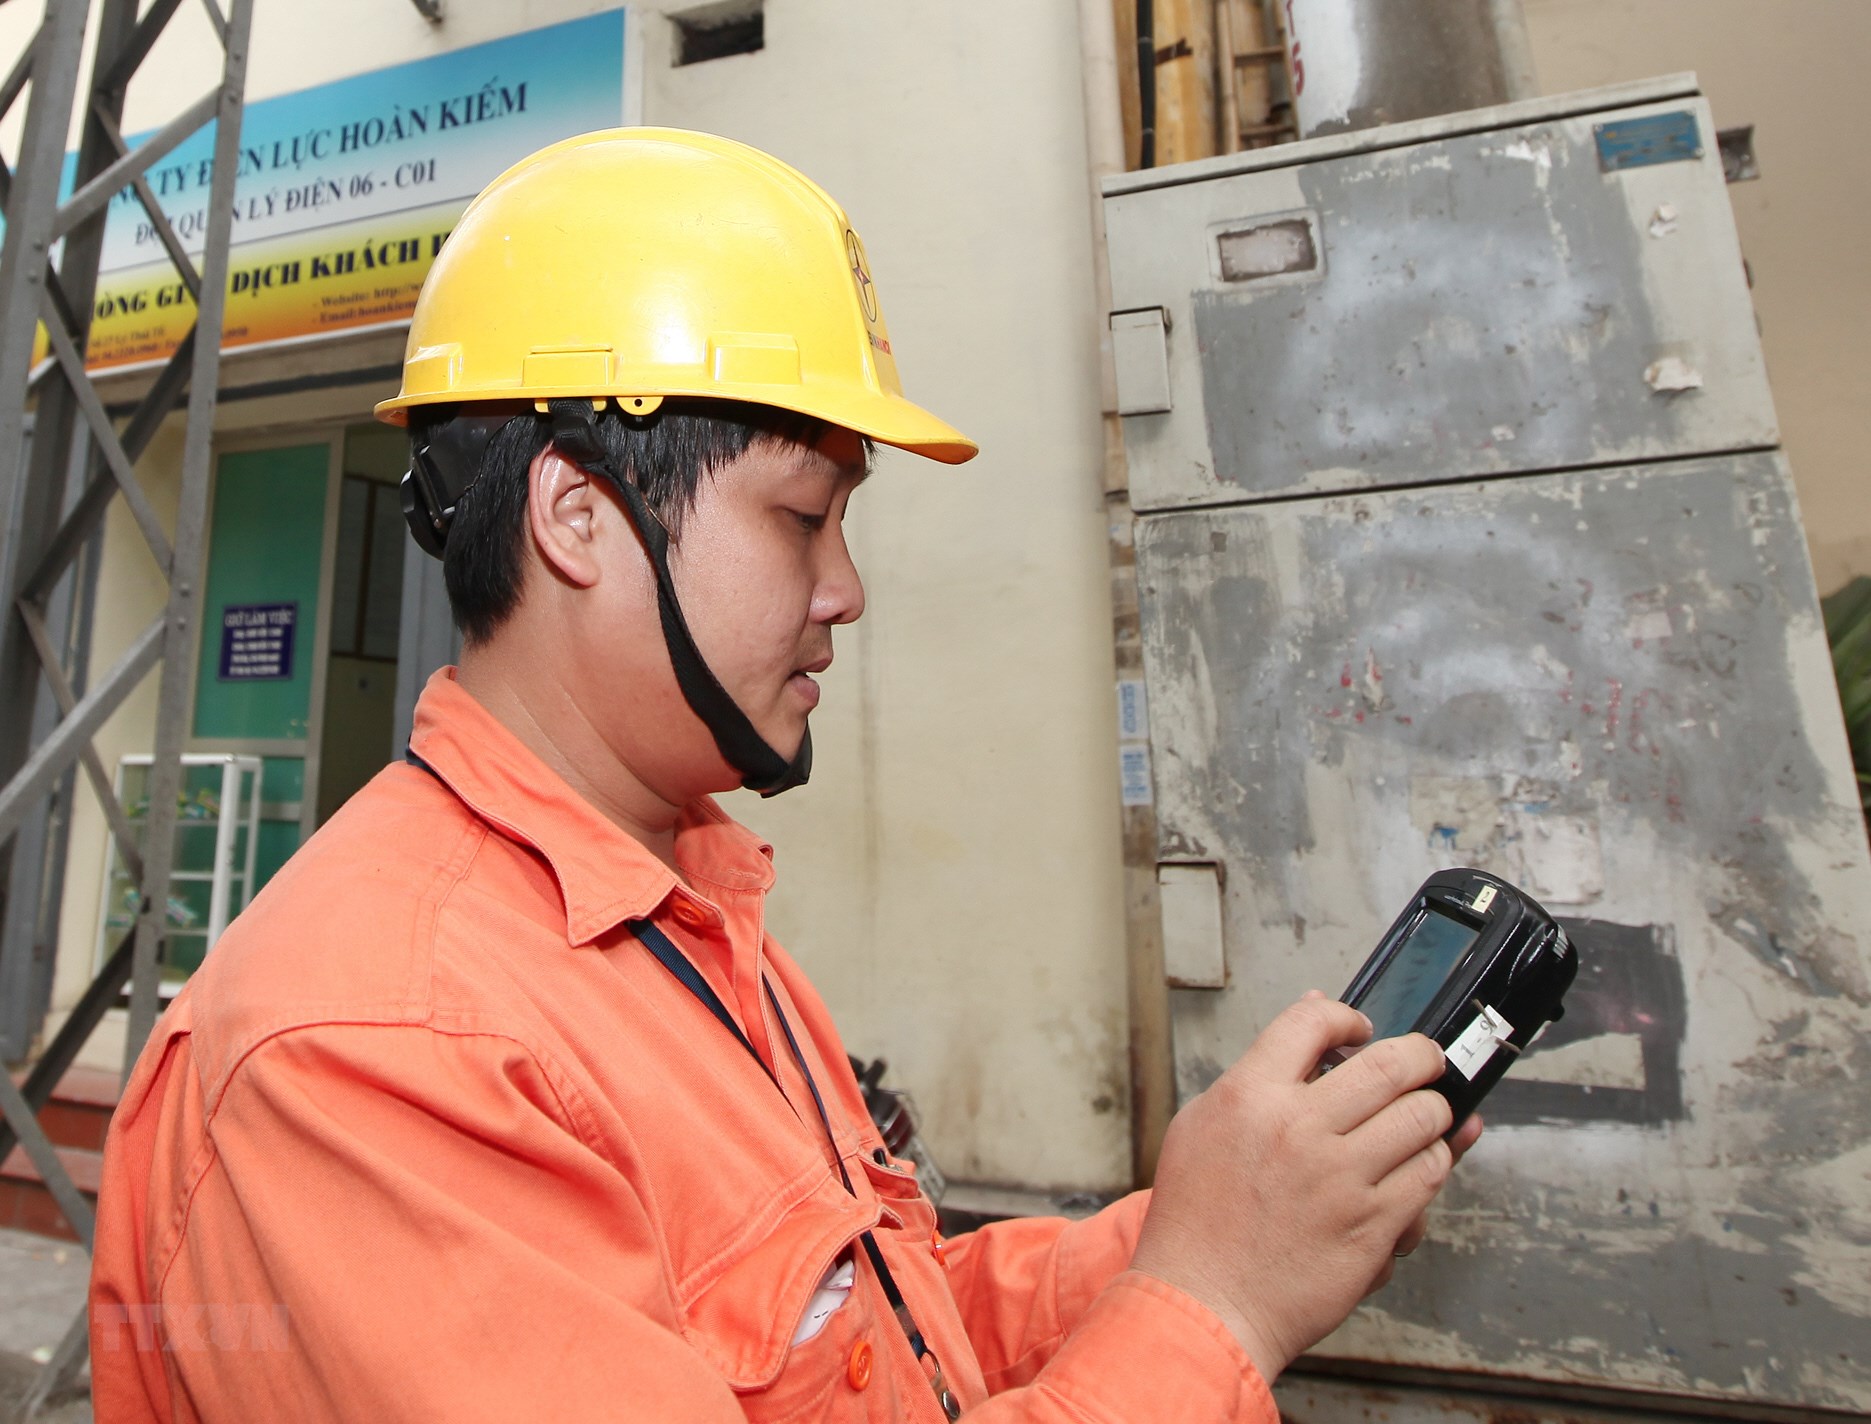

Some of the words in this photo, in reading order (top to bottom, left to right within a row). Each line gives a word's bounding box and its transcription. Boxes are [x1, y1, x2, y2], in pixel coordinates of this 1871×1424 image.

[156, 162, 193, 196] TY
[197, 141, 265, 187] ĐN
[271, 128, 332, 170] LỰC
[339, 104, 430, 153] HOÀN
[438, 76, 529, 131] KIẾM
[179, 200, 243, 240] QUN
[248, 187, 279, 220] LÝ
[285, 176, 344, 213] ĐIỆN
[350, 176, 374, 198] 06
[395, 158, 436, 189] C01
[96, 291, 147, 320] ÒNG
[230, 260, 302, 297] DỊCH
[310, 237, 420, 280] KHÁCH
[1480, 891, 1490, 903] 2
